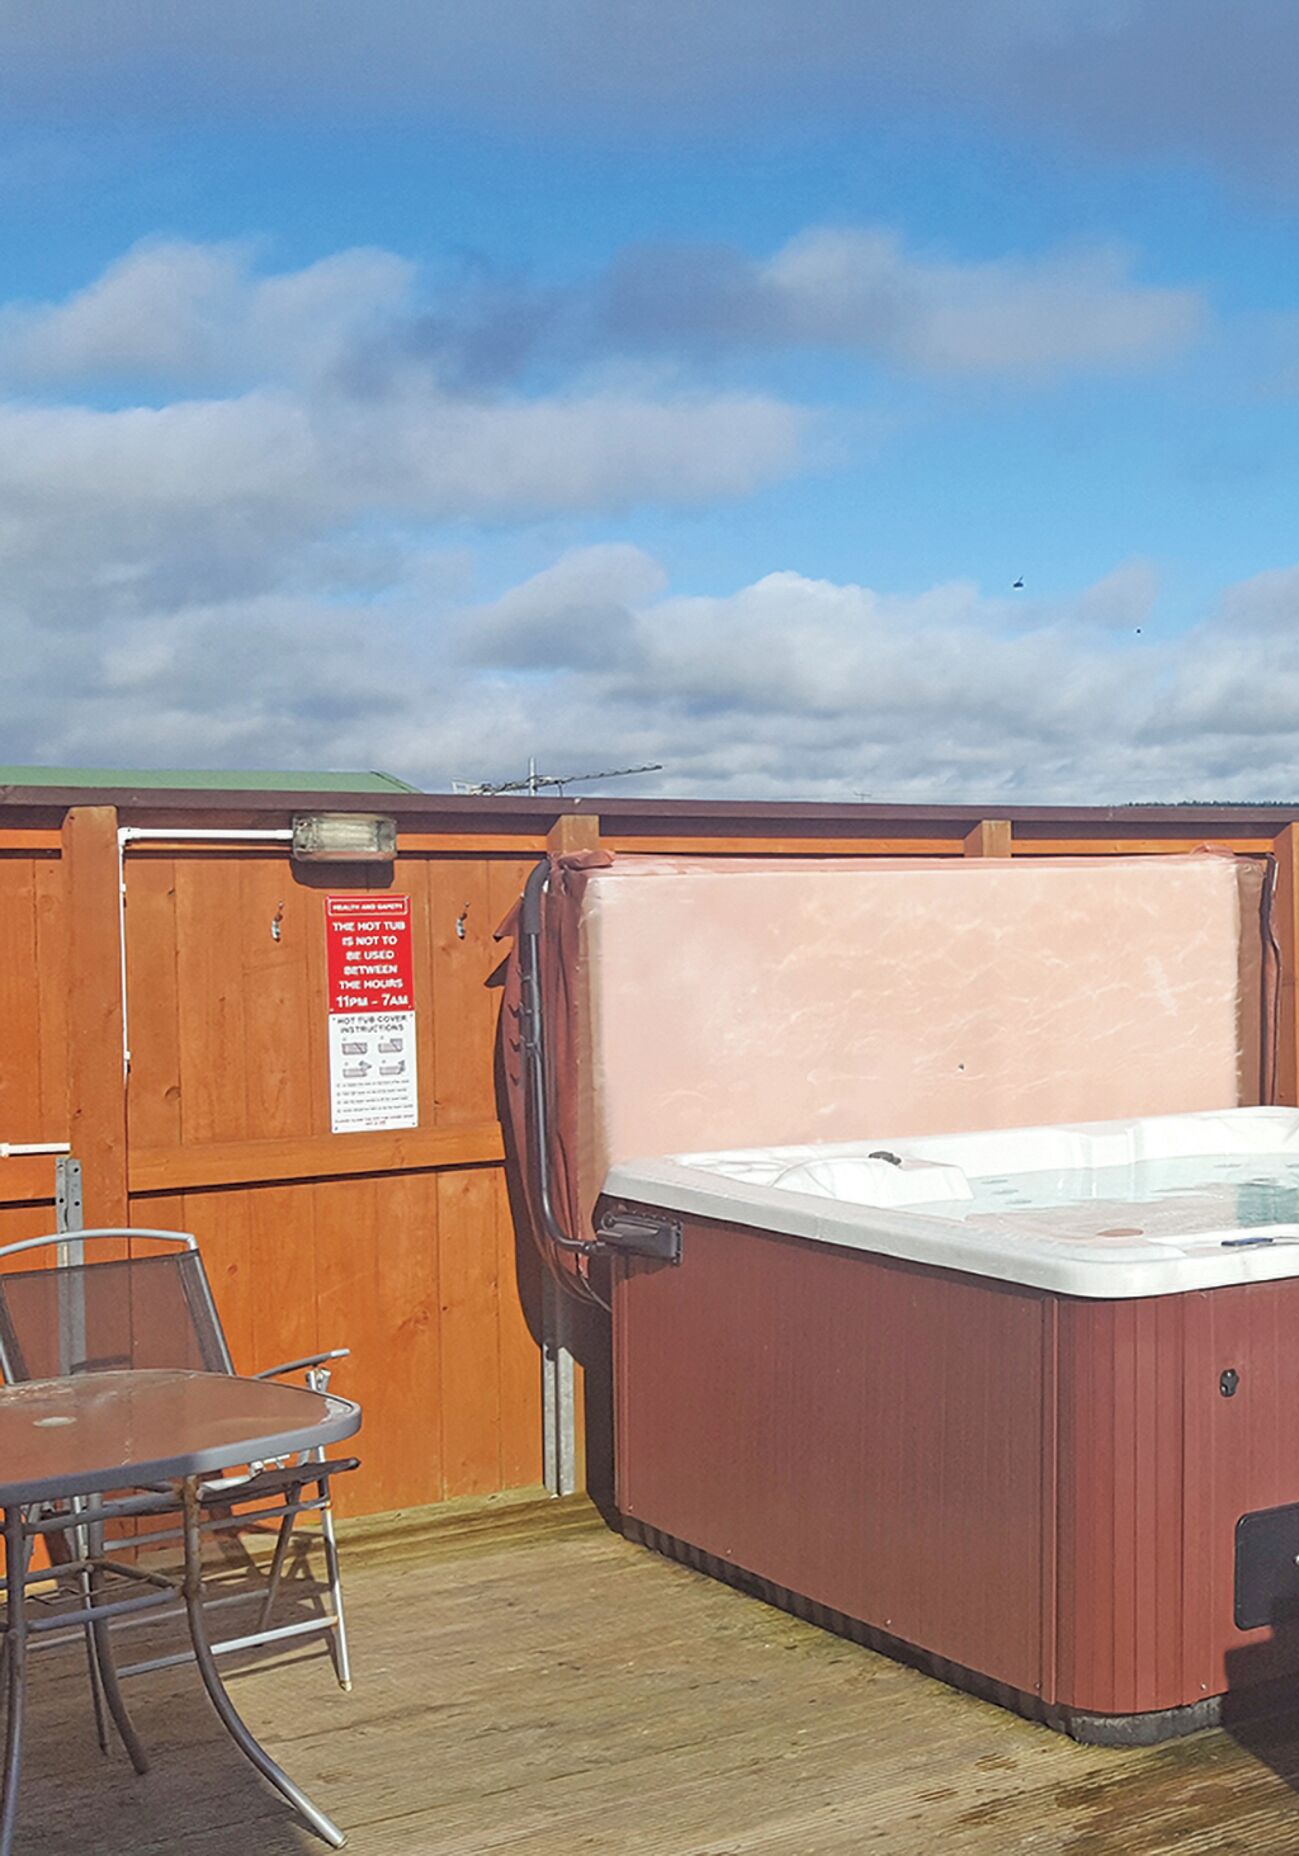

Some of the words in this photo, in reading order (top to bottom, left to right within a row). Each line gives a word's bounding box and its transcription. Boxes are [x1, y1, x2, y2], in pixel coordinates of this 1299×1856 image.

[332, 922, 355, 932] THE
[357, 922, 381, 930] HOT
[383, 921, 406, 930] TUB
[342, 936, 354, 946] IS
[356, 936, 380, 945] NOT
[382, 936, 398, 945] TO
[346, 951, 361, 961] BE
[364, 950, 395, 960] USED
[344, 965, 398, 976] BETWEEN
[339, 980, 361, 990] THE
[364, 979, 403, 989] HOURS
[336, 995, 368, 1008] 11PM
[381, 993, 409, 1006] 7AM
[337, 1016, 355, 1025] HOT
[358, 1016, 375, 1024] TUB
[340, 1024, 404, 1034] INSTRUCTIONS
